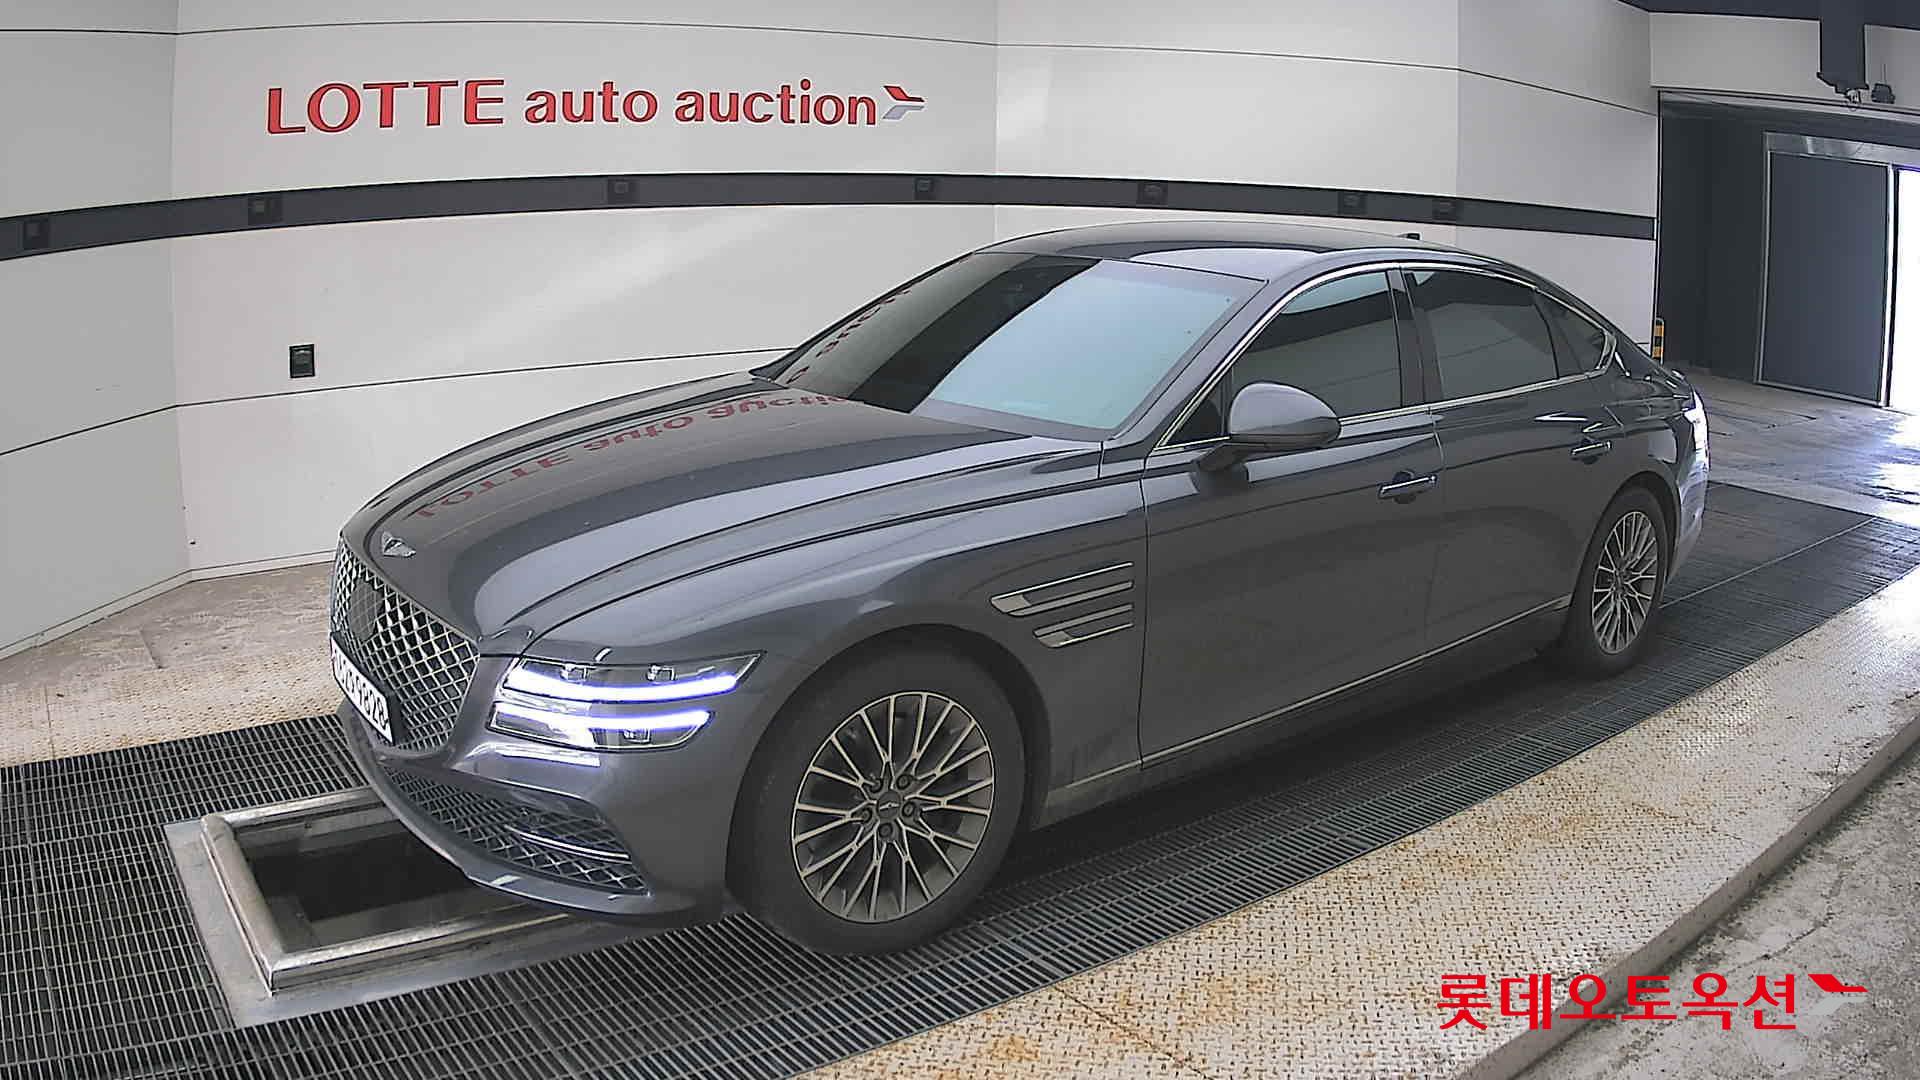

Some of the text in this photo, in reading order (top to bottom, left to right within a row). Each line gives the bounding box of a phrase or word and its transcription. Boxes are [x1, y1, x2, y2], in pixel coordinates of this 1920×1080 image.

[267, 78, 877, 135] LOTTE auto auction
